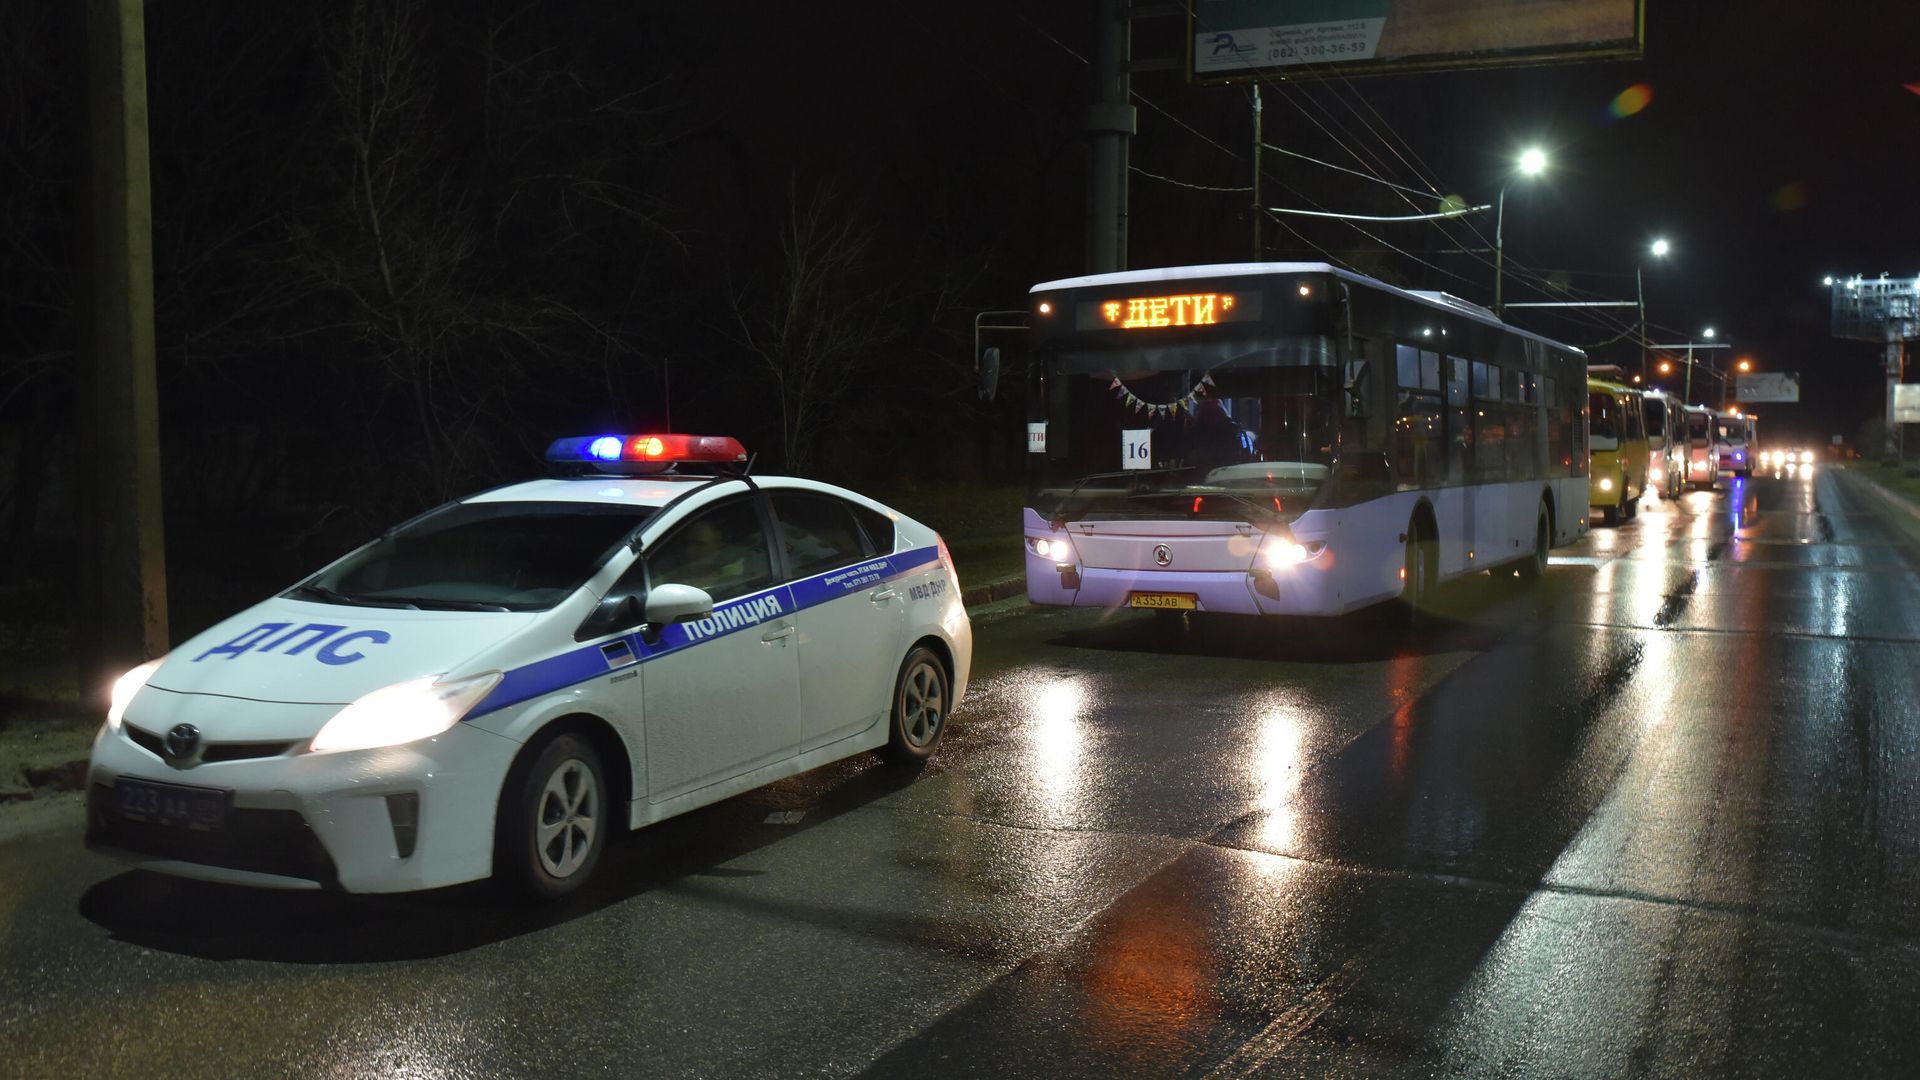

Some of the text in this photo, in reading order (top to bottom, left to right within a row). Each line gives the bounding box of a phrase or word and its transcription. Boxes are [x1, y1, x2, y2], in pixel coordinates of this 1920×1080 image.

[1303, 42, 1366, 56] 300-36-59
[1123, 293, 1217, 328] ДЕТИ
[1129, 442, 1148, 459] 16
[908, 579, 947, 601] МВД ДНР
[681, 594, 783, 641] ПОЛИЦИЯ
[192, 622, 391, 666] ДПС
